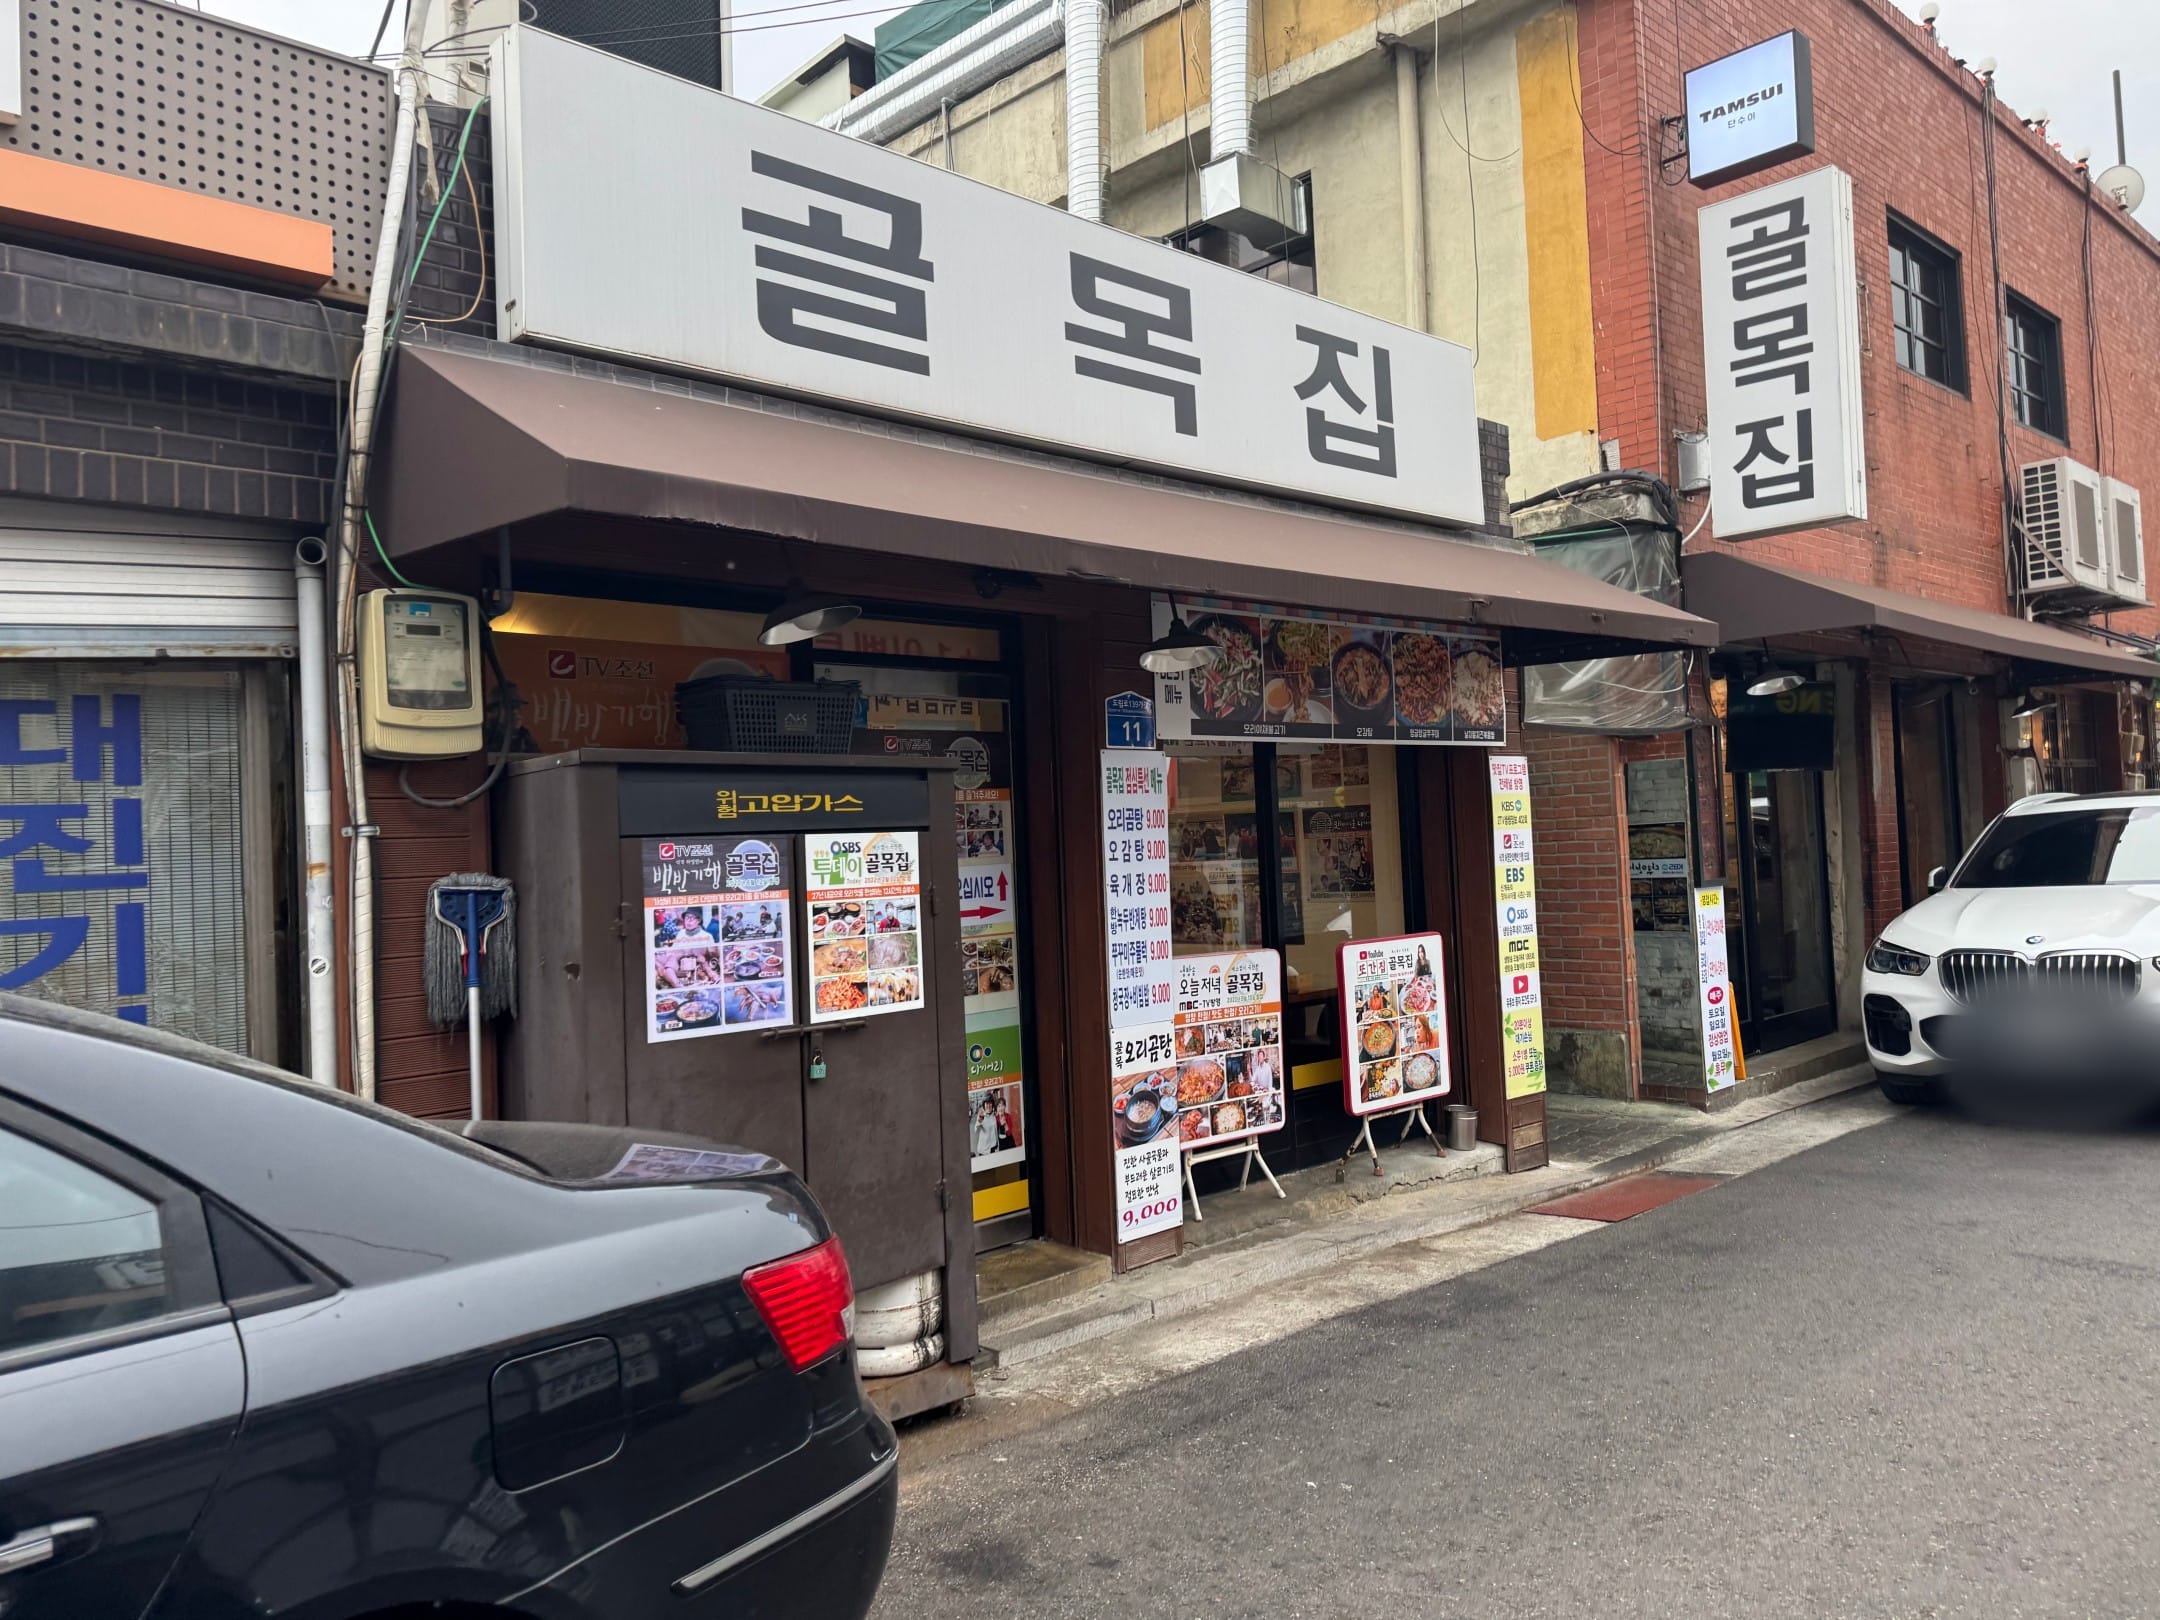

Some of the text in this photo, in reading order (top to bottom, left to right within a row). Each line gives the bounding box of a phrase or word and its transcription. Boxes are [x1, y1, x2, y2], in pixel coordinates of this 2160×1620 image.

[1699, 83, 1783, 123] TAMSUI
[1728, 111, 1756, 129] 단수이
[742, 149, 1398, 478] 골목집
[1726, 196, 1815, 509] 골목집
[1165, 685, 1183, 704] 메뉴
[1123, 721, 1140, 741] 11
[1356, 727, 1373, 737] 오감탕
[1106, 767, 1124, 794] 골목집
[1150, 767, 1163, 794] 메뉴
[738, 794, 863, 812] 고압가스
[1501, 801, 1515, 812] KBS
[1107, 807, 1165, 832] 오리곰탕 9.000
[842, 841, 861, 853] SBS
[1147, 840, 1165, 860] 9.000
[726, 852, 779, 877] 골목집
[811, 857, 862, 885] 투데이
[866, 852, 909, 873] 골목집
[653, 858, 721, 895] 백반기행
[1148, 873, 1167, 893] 9.000
[1505, 867, 1525, 882] EBS
[1149, 907, 1167, 927] 9.000
[1517, 909, 1528, 919] SBS
[1150, 940, 1169, 961] 9.000
[1358, 961, 1386, 976] 또간집
[1388, 954, 1413, 971] 골목집
[1227, 972, 1264, 994] 골목집
[1152, 983, 1171, 1004] 9.000
[1709, 1006, 1725, 1018] 토요일
[1710, 1018, 1726, 1031] 일요일
[1124, 1033, 1173, 1064] 오리곰탕
[1709, 1030, 1729, 1047] 정상영업
[1123, 1148, 1169, 1169] 진한 사골국물과
[1124, 1163, 1175, 1186] 부드러운 살코기의
[1145, 1182, 1160, 1197] 만남
[1122, 1197, 1178, 1228] 9,000
